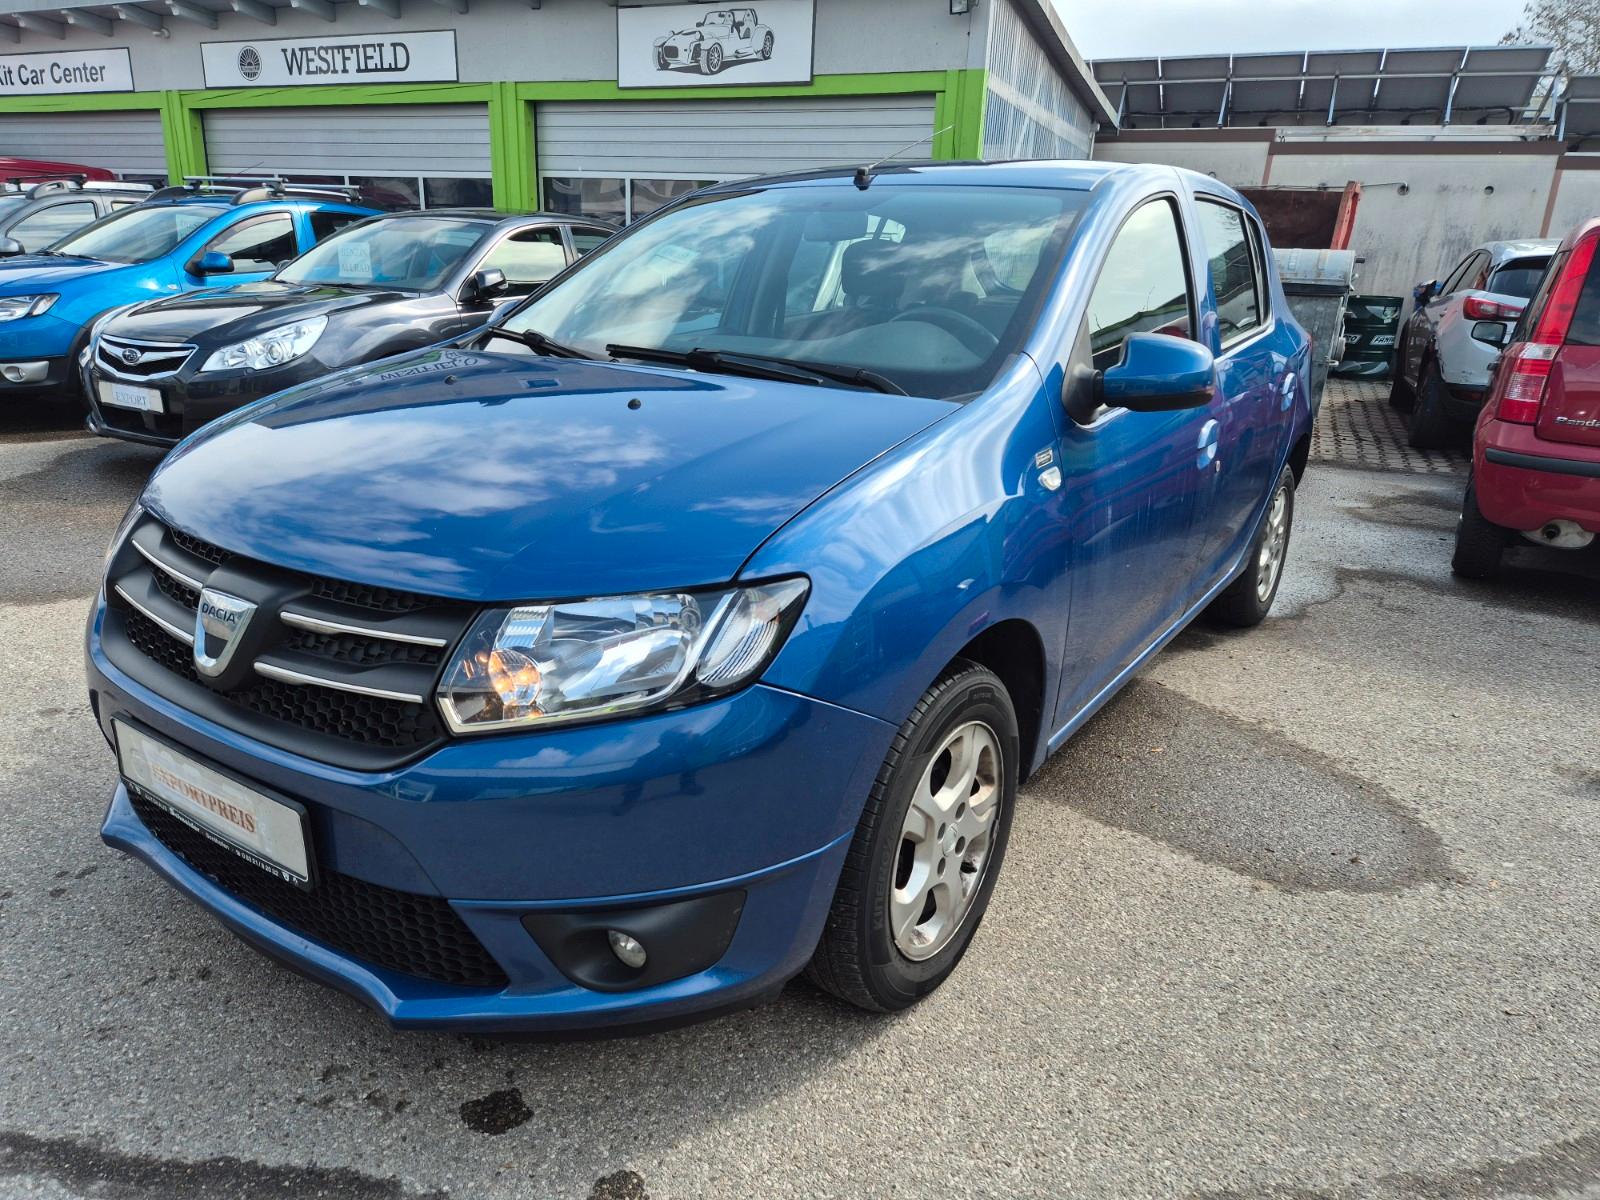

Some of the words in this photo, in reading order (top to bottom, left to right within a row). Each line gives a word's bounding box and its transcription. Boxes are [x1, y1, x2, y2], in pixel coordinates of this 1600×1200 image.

[281, 42, 410, 76] WESTFIELD
[18, 64, 46, 86] Car
[50, 61, 106, 84] Center
[201, 602, 236, 624] DACIA
